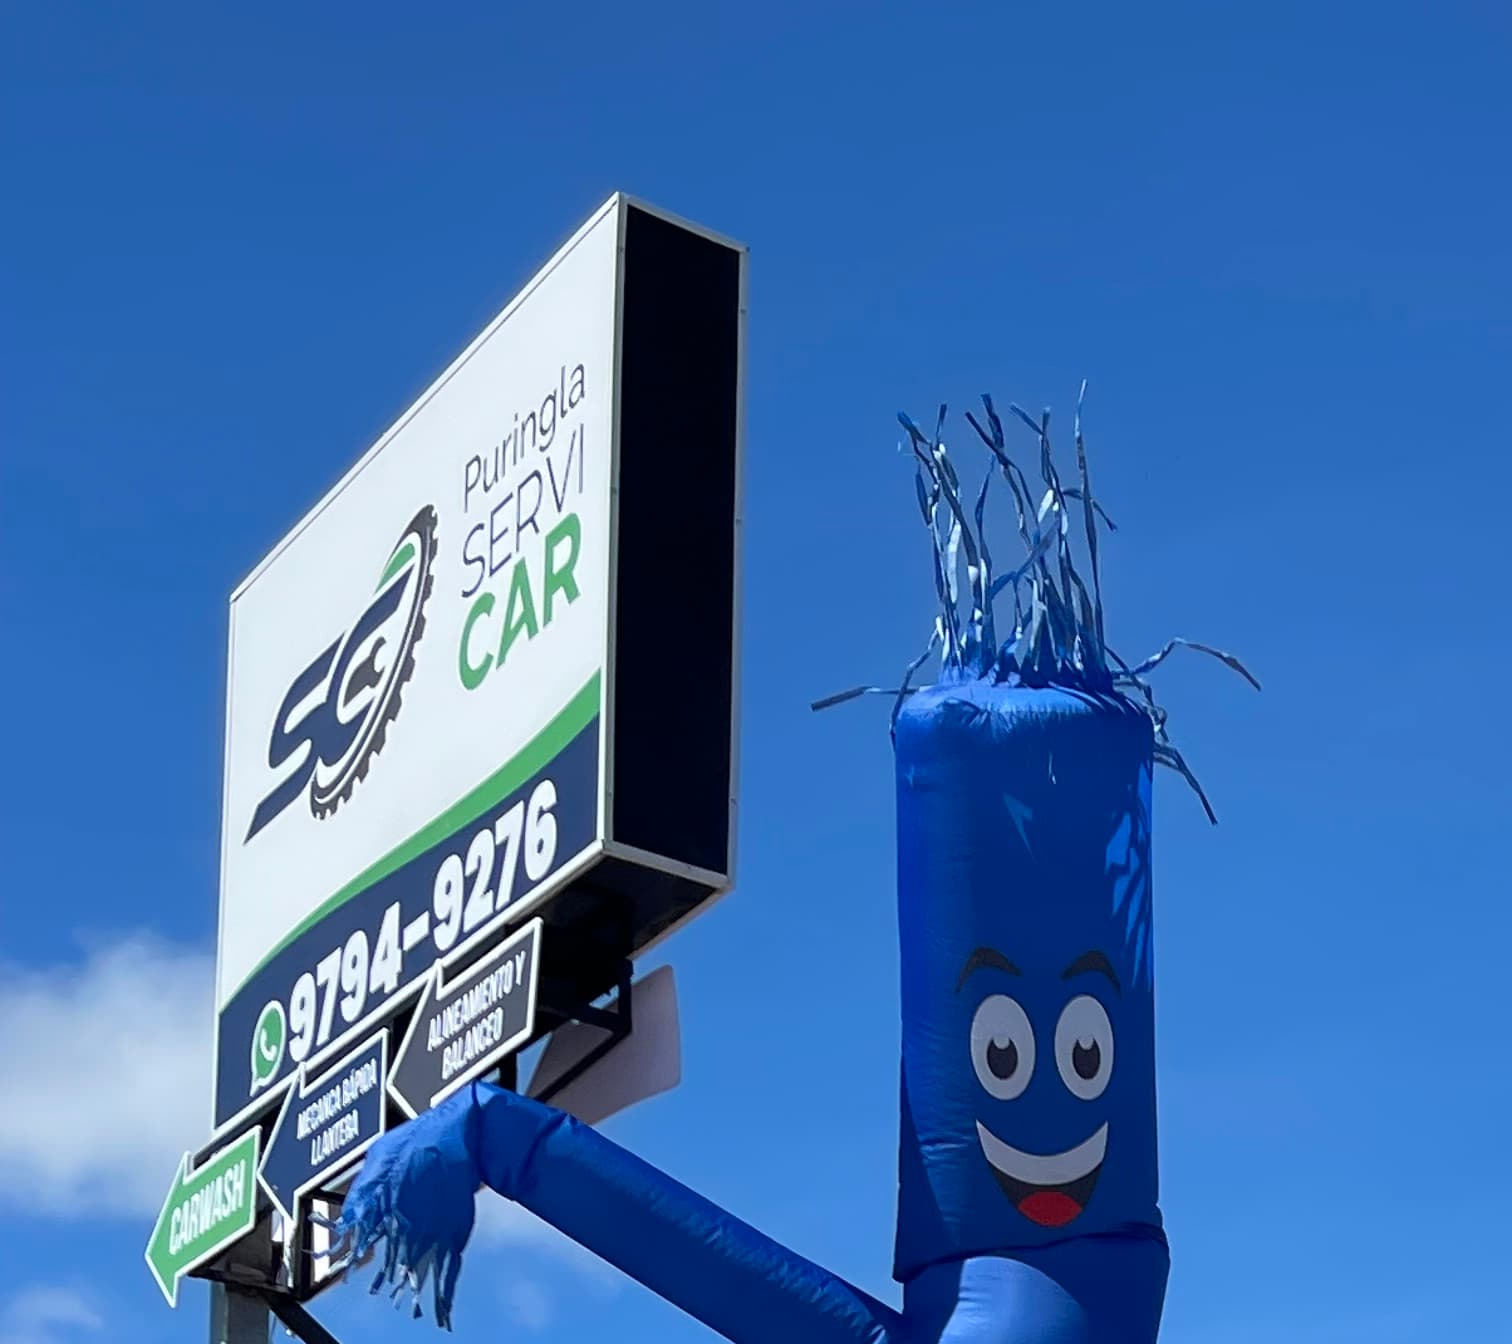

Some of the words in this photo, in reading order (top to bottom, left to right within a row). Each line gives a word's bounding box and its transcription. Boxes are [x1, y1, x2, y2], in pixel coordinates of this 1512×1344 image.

[463, 361, 586, 514] Puringla
[460, 422, 585, 598] SERVI
[457, 511, 582, 691] CAR
[288, 779, 558, 1062] 9794-9276
[427, 959, 513, 1051] ALINEAMIENTO
[514, 950, 527, 986] Y
[441, 1006, 504, 1080] BALANCEO
[310, 1108, 360, 1166] LLANTERA
[167, 1158, 247, 1255] CARWASH
